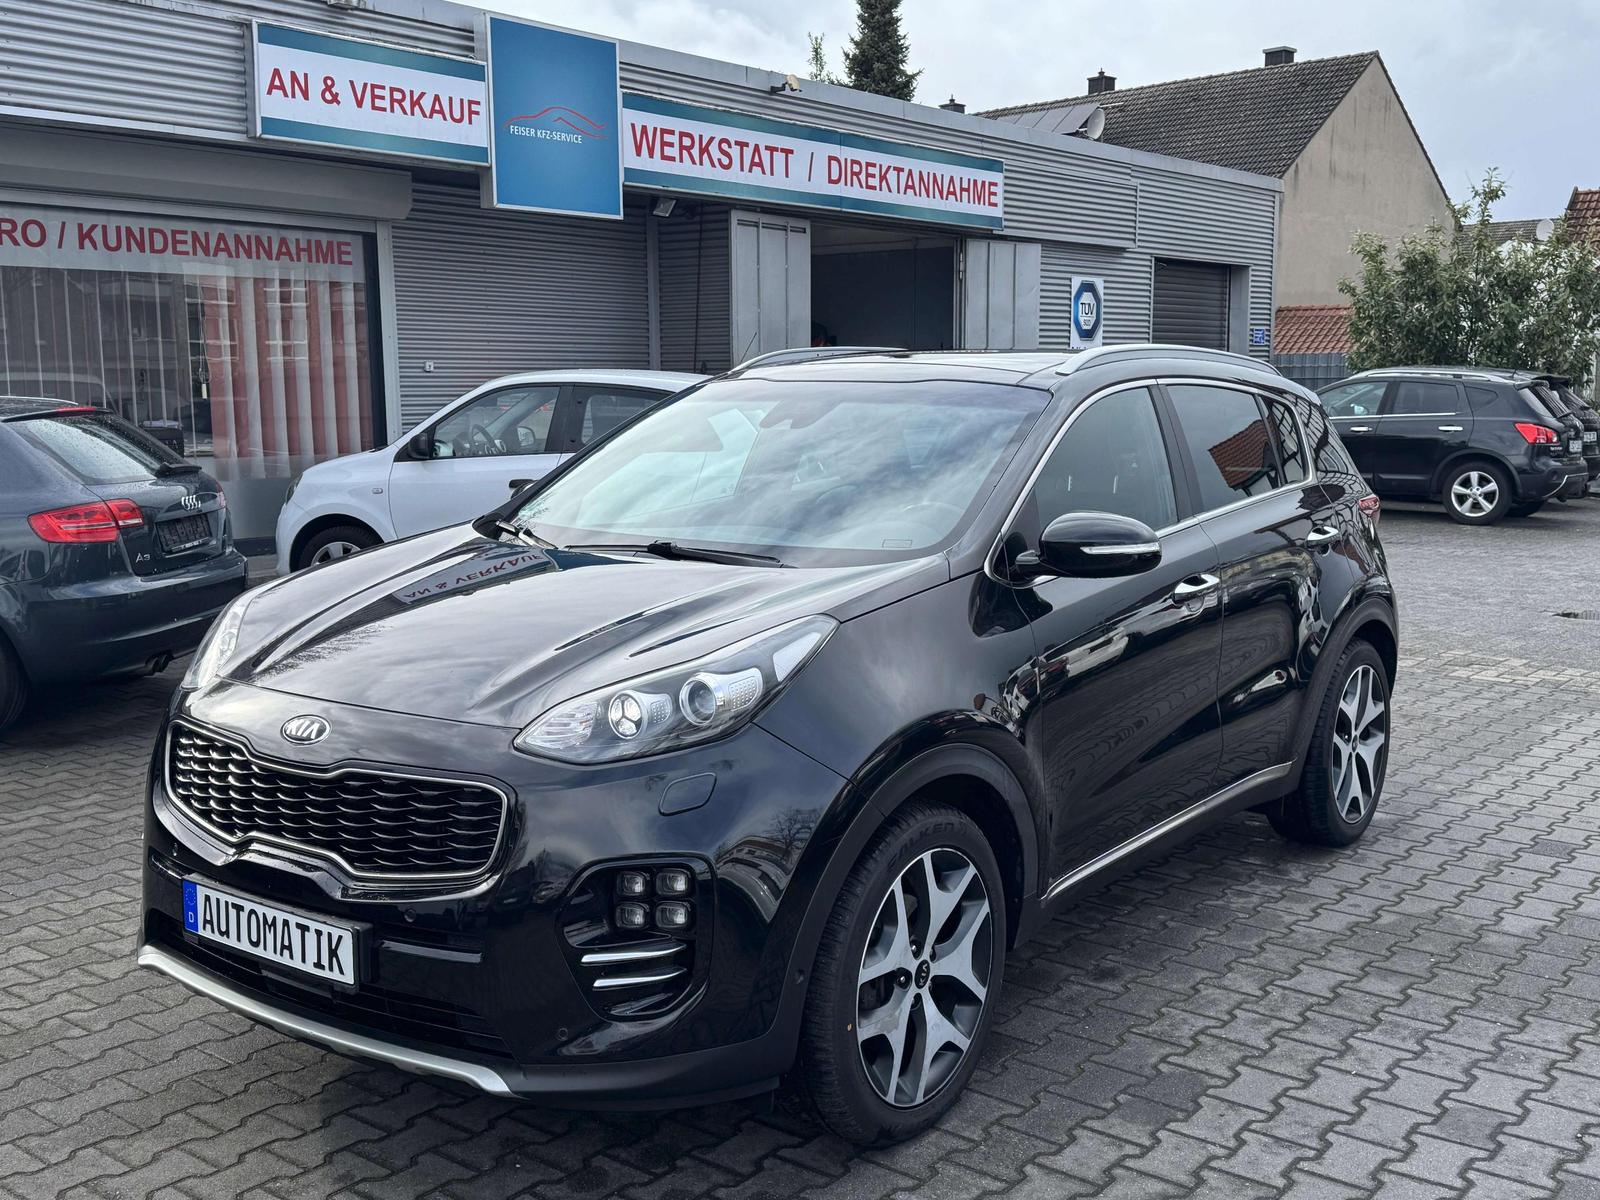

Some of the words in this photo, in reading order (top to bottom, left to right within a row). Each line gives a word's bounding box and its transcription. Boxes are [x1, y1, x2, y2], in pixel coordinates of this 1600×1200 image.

[266, 67, 309, 101] AN
[320, 75, 341, 106] &
[349, 79, 481, 125] VERKAUF
[510, 125, 535, 138] FEISER
[536, 129, 582, 144] KFZ-SERVICE
[630, 122, 794, 178] WERKSTATT
[808, 151, 814, 182] /
[827, 154, 998, 207] DIREKTANNAHME
[57, 221, 66, 249] /
[77, 222, 353, 266] KUNDENANNAHME
[135, 552, 151, 563] A3
[285, 718, 321, 740] KIA
[188, 911, 195, 923] D
[202, 893, 346, 976] AUTOMATIK
